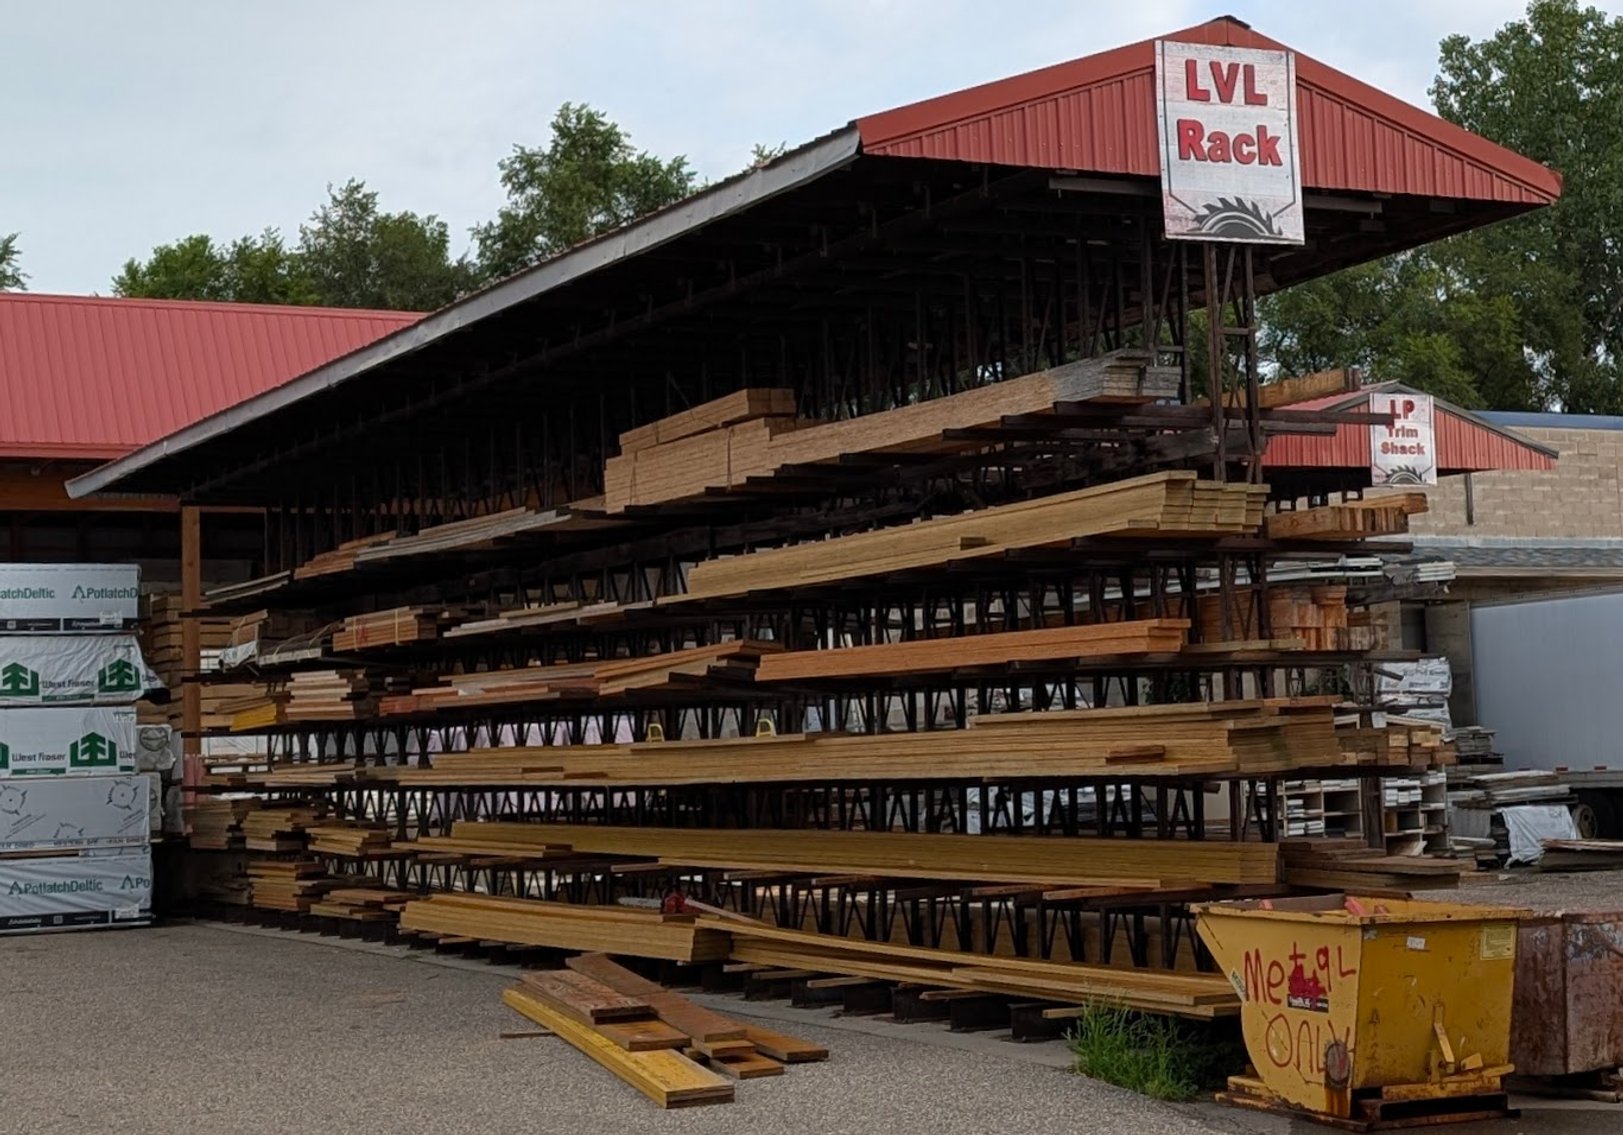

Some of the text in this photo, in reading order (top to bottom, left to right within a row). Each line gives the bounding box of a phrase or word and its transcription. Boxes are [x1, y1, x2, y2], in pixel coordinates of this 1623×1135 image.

[1185, 59, 1268, 106] LVL
[1177, 119, 1284, 167] Rack
[1389, 399, 1416, 420] LP
[1385, 424, 1419, 438] Trim
[1380, 441, 1426, 456] Shack
[41, 680, 66, 689] West
[12, 752, 36, 762] West
[24, 879, 103, 895] PotlatchDeltic
